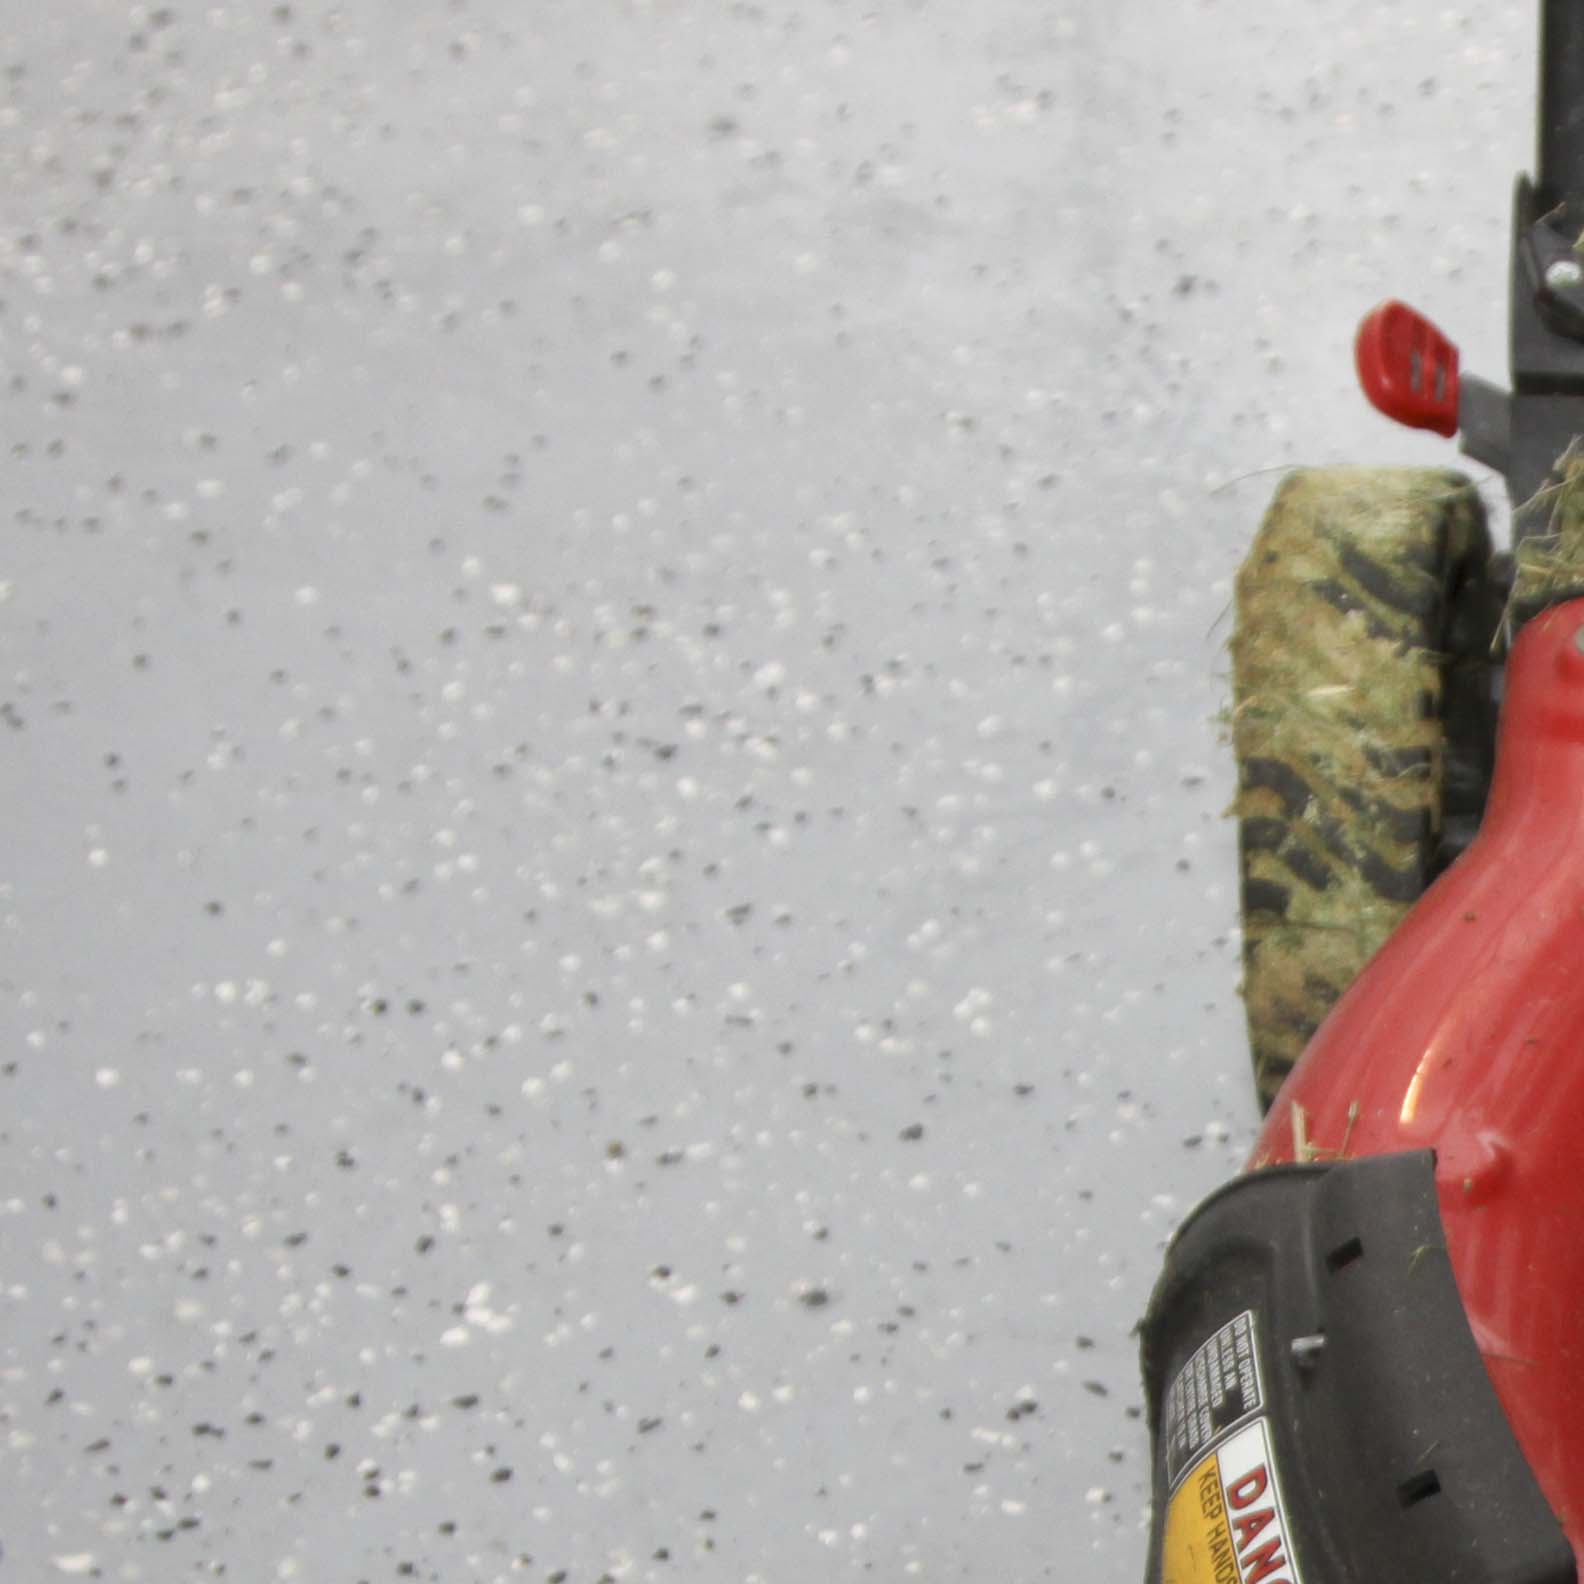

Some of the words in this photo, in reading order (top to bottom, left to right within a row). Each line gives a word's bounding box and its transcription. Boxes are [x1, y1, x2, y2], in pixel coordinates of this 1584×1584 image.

[1235, 1333, 1250, 1359] NOT
[1238, 1358, 1257, 1411] OPERATE
[1198, 1465, 1222, 1519] KEEP
